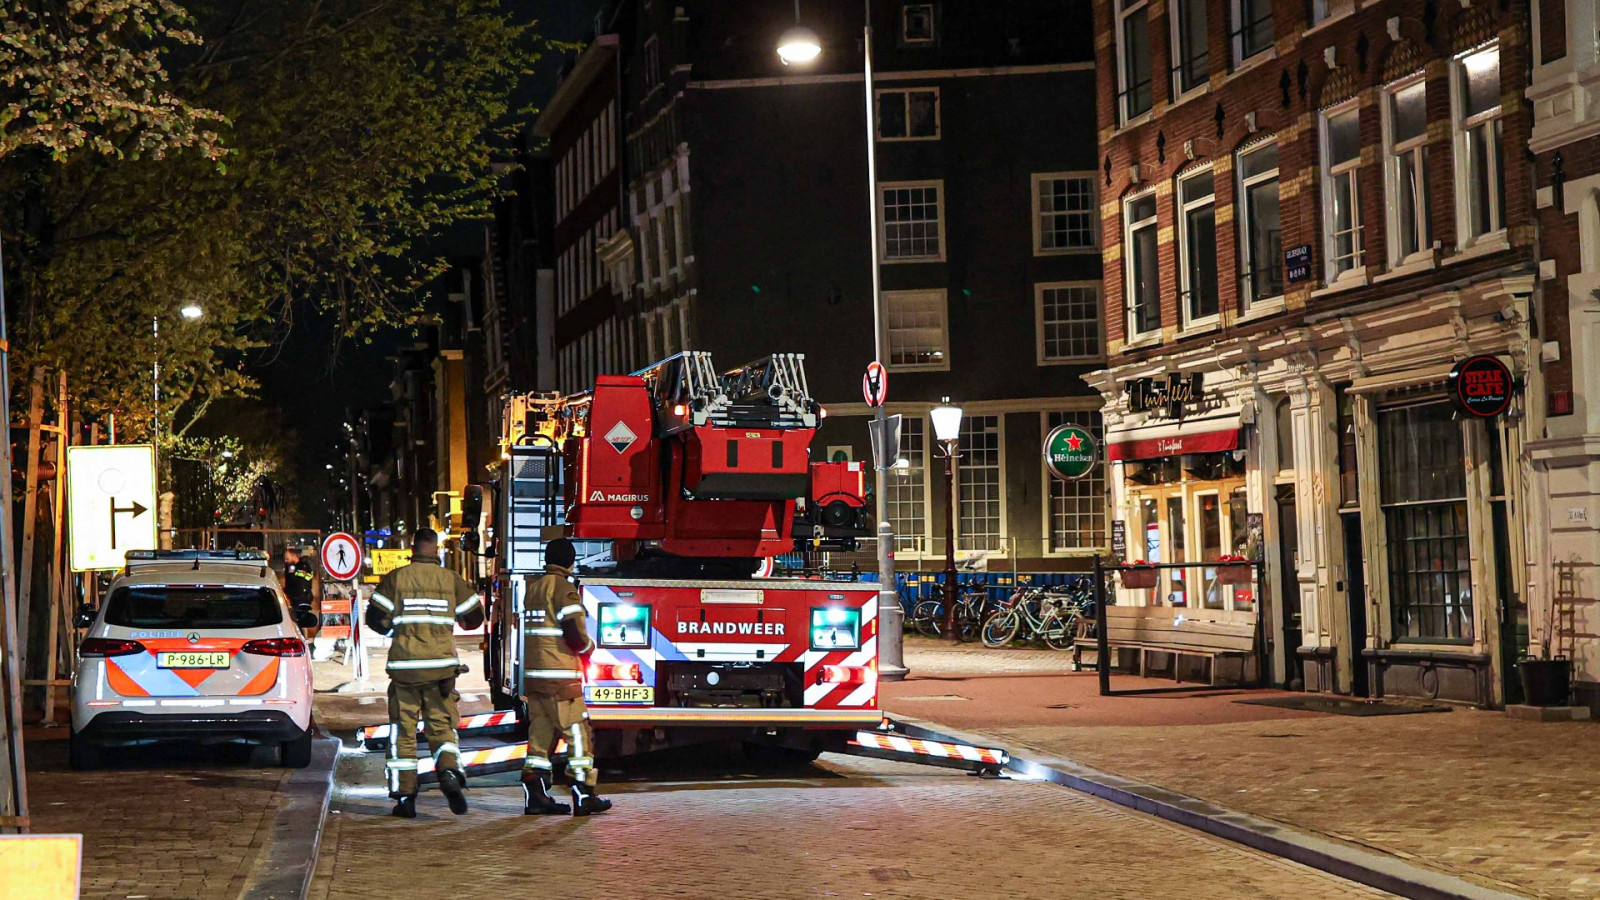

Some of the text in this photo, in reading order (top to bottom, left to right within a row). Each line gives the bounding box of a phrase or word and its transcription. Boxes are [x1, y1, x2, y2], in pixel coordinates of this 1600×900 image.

[1465, 370, 1503, 384] STEAK
[1466, 382, 1504, 396] CAFE
[1054, 453, 1093, 462] Heineken
[607, 494, 649, 502] MAGIRUS
[677, 621, 785, 635] BRANDWEER
[130, 629, 183, 639] POLITIE
[167, 654, 224, 665] P-986-LR
[594, 688, 649, 700] 49-BHF-3
